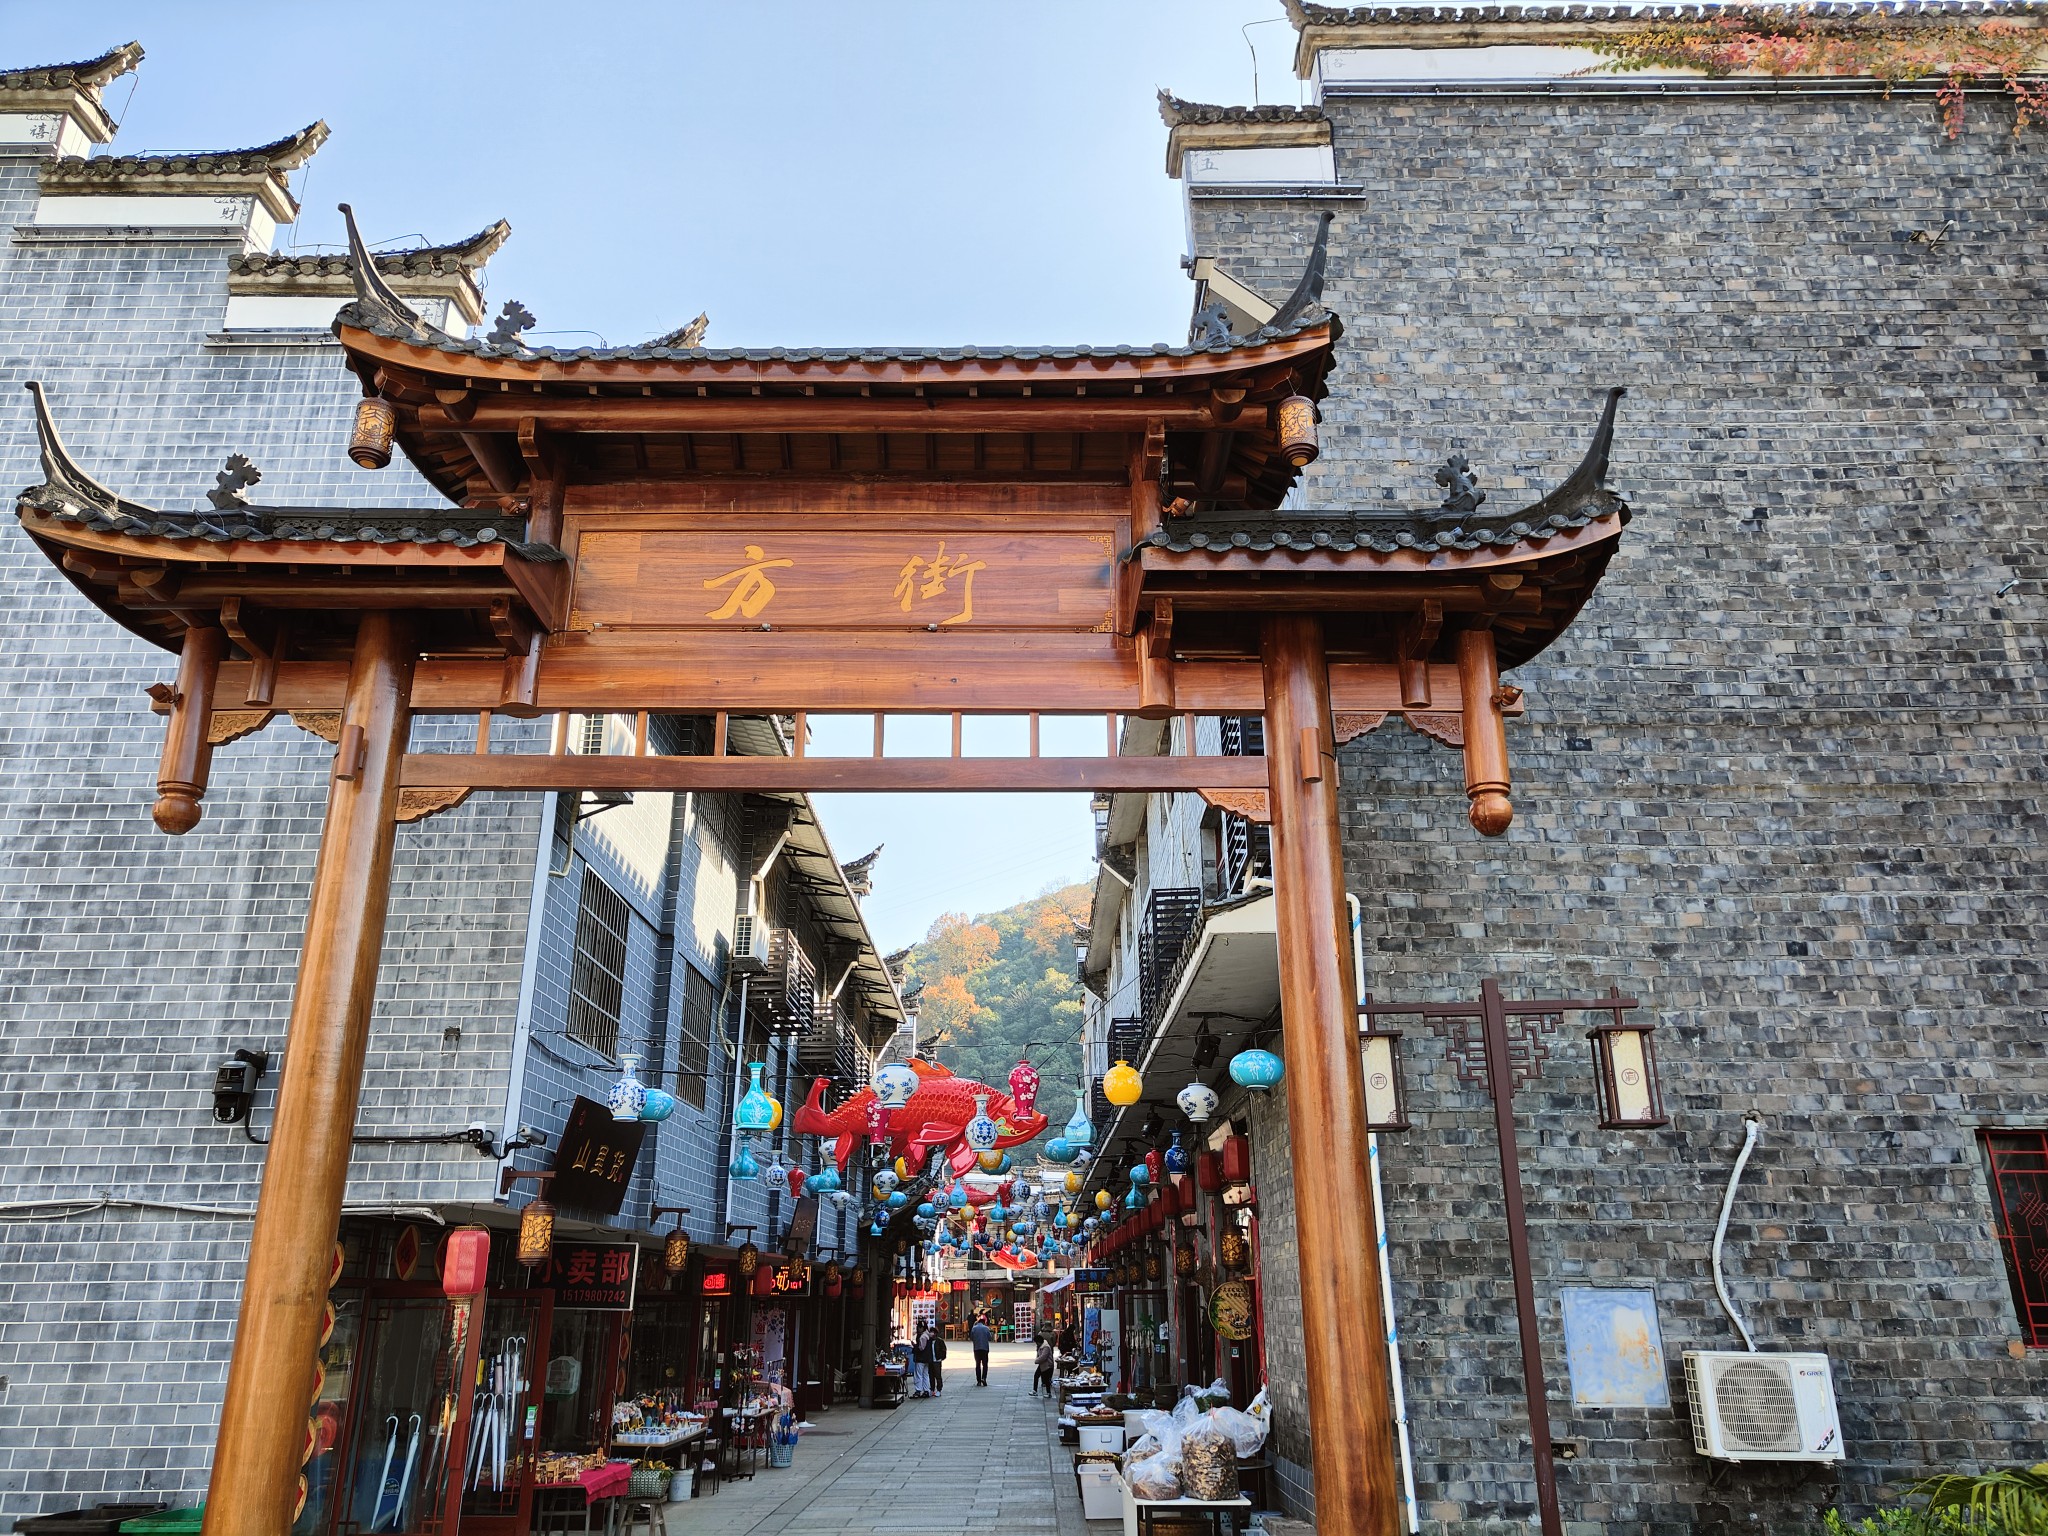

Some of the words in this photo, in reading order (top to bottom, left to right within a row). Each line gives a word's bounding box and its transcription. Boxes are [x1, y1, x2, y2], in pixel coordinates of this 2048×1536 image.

[1199, 157, 1219, 172] 五
[219, 205, 239, 221] 财
[534, 1249, 631, 1286] 小卖部
[562, 1289, 626, 1303] 15179807242
